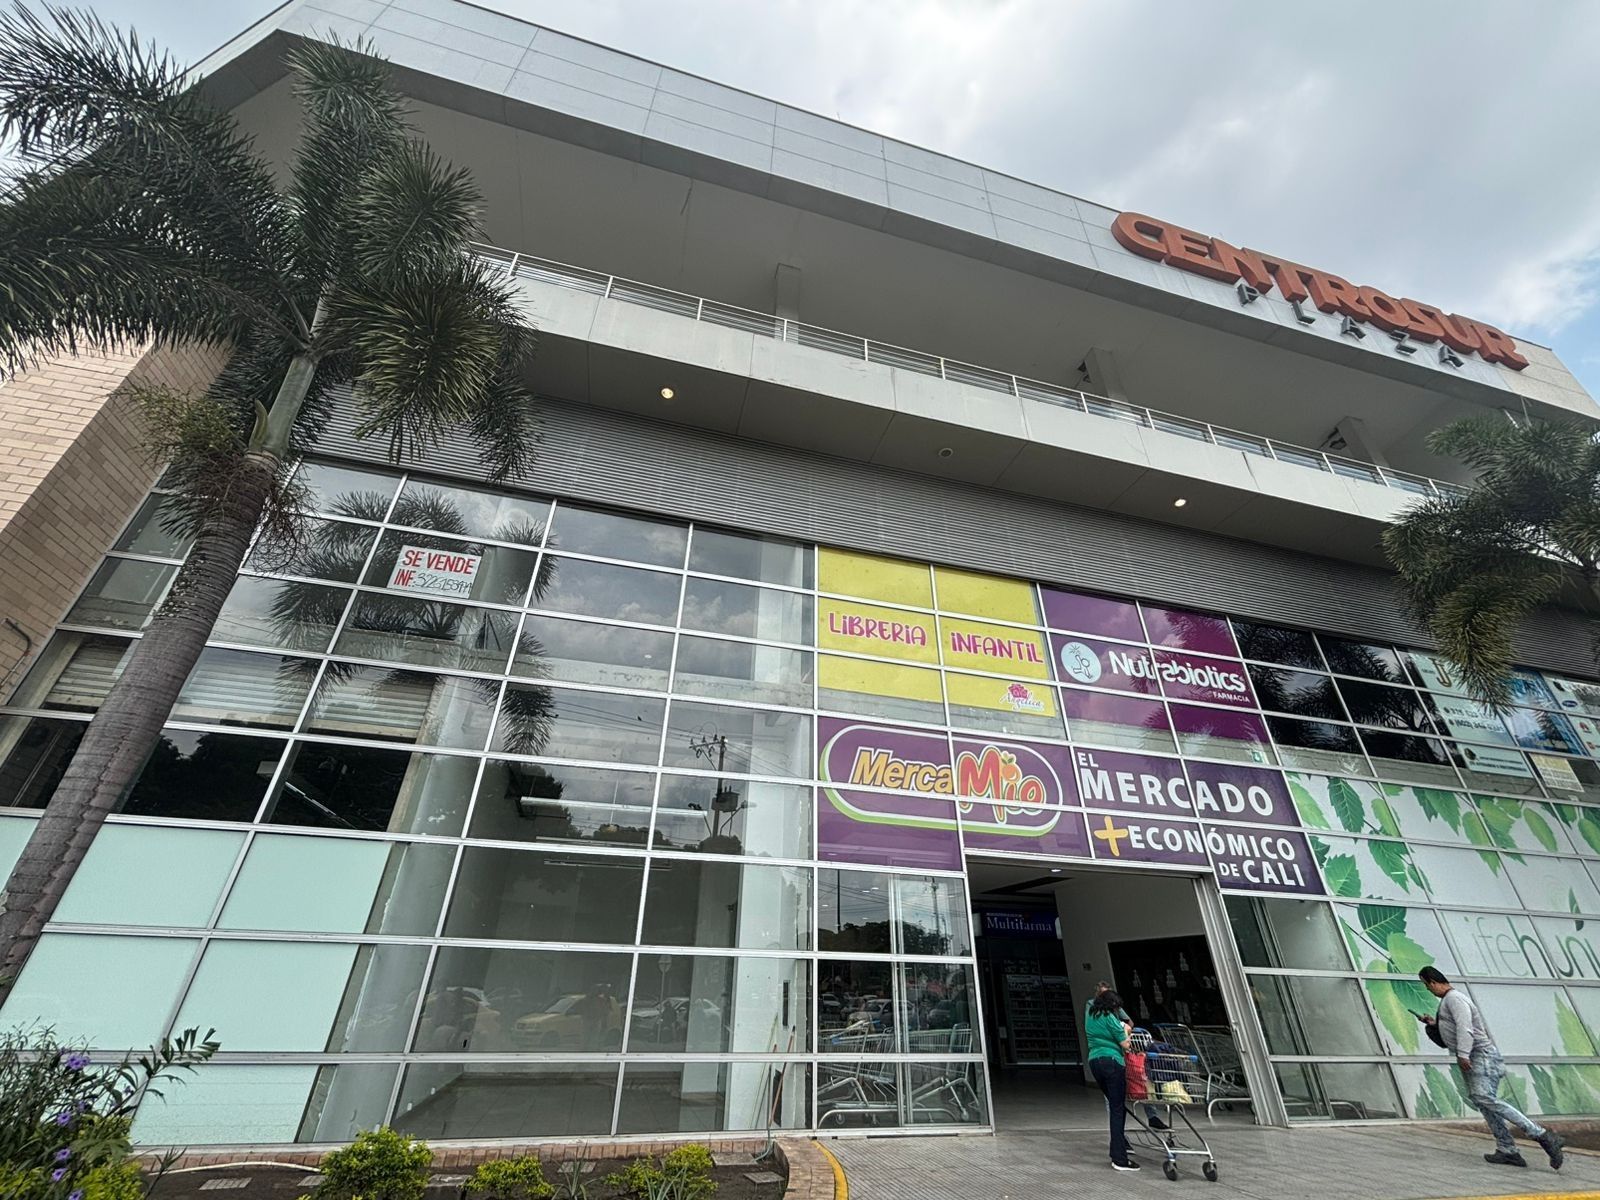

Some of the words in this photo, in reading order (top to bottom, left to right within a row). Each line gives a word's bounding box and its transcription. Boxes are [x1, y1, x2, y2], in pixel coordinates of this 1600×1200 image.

[1111, 211, 1530, 371] CENTROSUR
[1236, 283, 1465, 369] PLAZA
[402, 549, 425, 568] SE
[427, 552, 476, 575] VENDE
[1212, 691, 1250, 703] FARMACIA
[1077, 752, 1099, 768] EL
[1080, 768, 1274, 816] MERCADO
[1218, 862, 1240, 877] DE
[1242, 860, 1306, 887] CALI
[986, 916, 1053, 931] Multifarma
